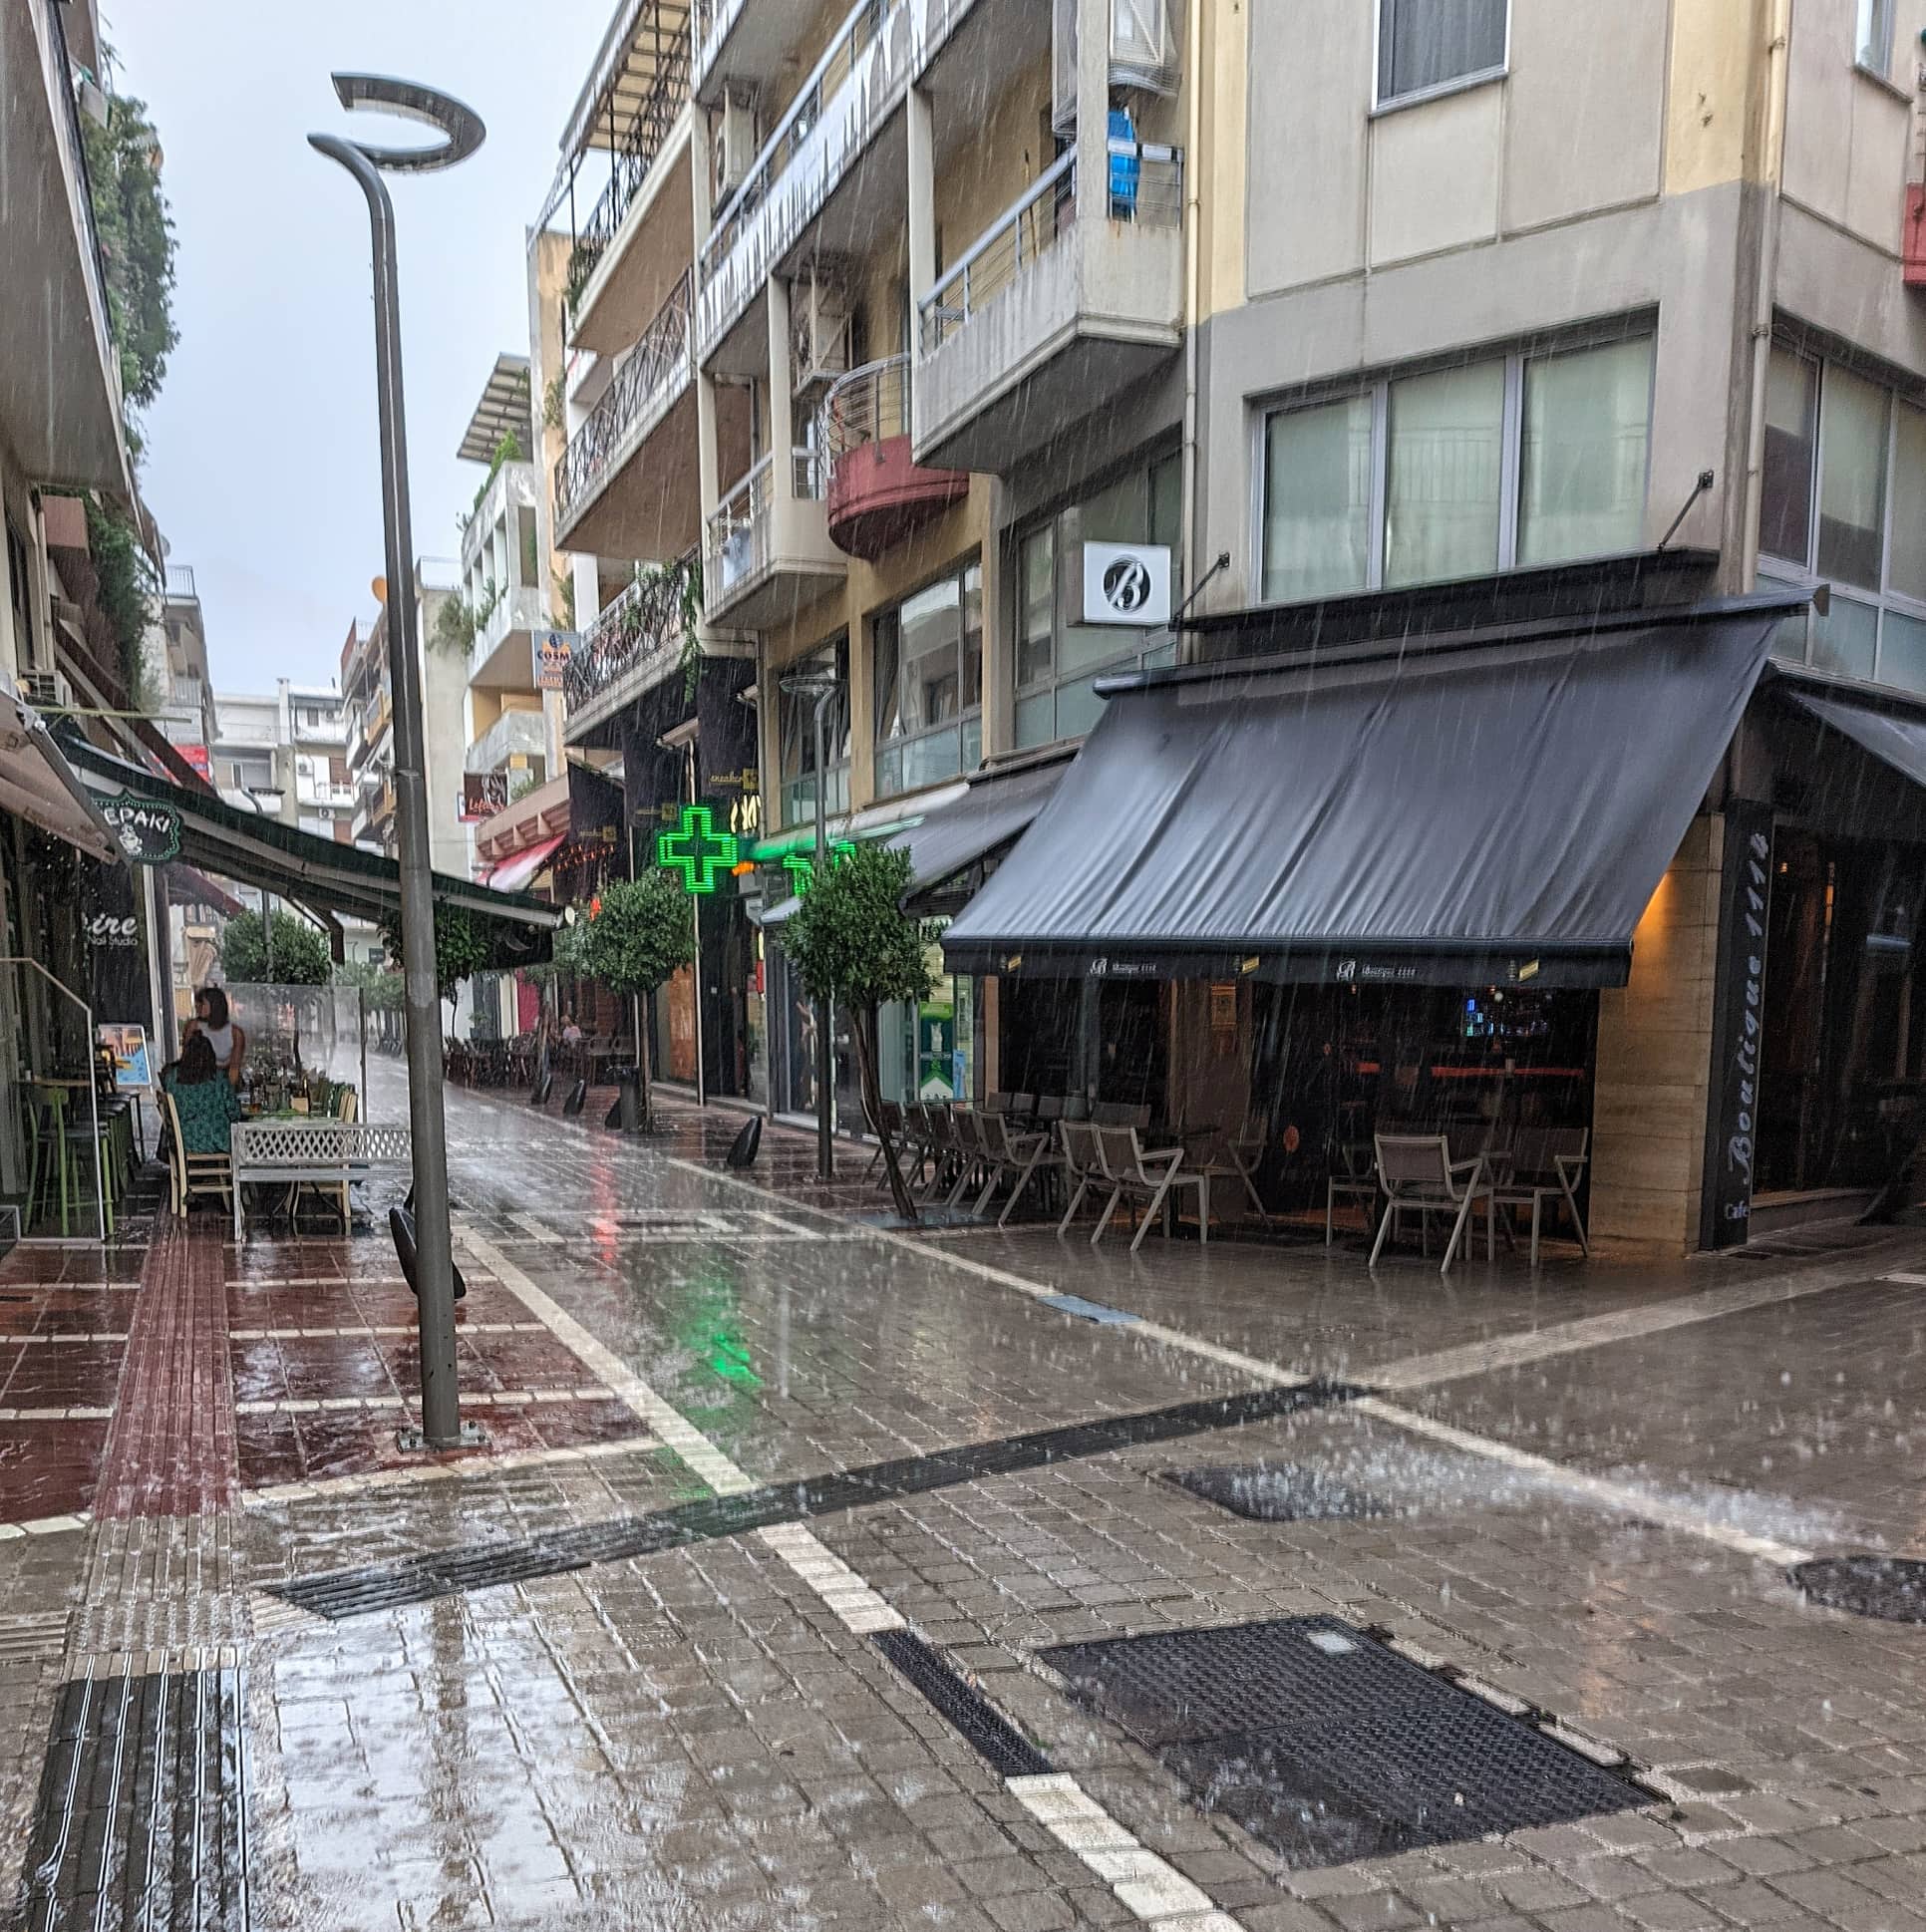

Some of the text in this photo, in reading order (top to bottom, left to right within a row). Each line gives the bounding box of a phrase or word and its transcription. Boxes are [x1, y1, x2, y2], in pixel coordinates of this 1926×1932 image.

[537, 650, 572, 660] COSM
[101, 806, 170, 833] ΕΡΑΚΙ
[1728, 955, 1763, 1185] Boutique
